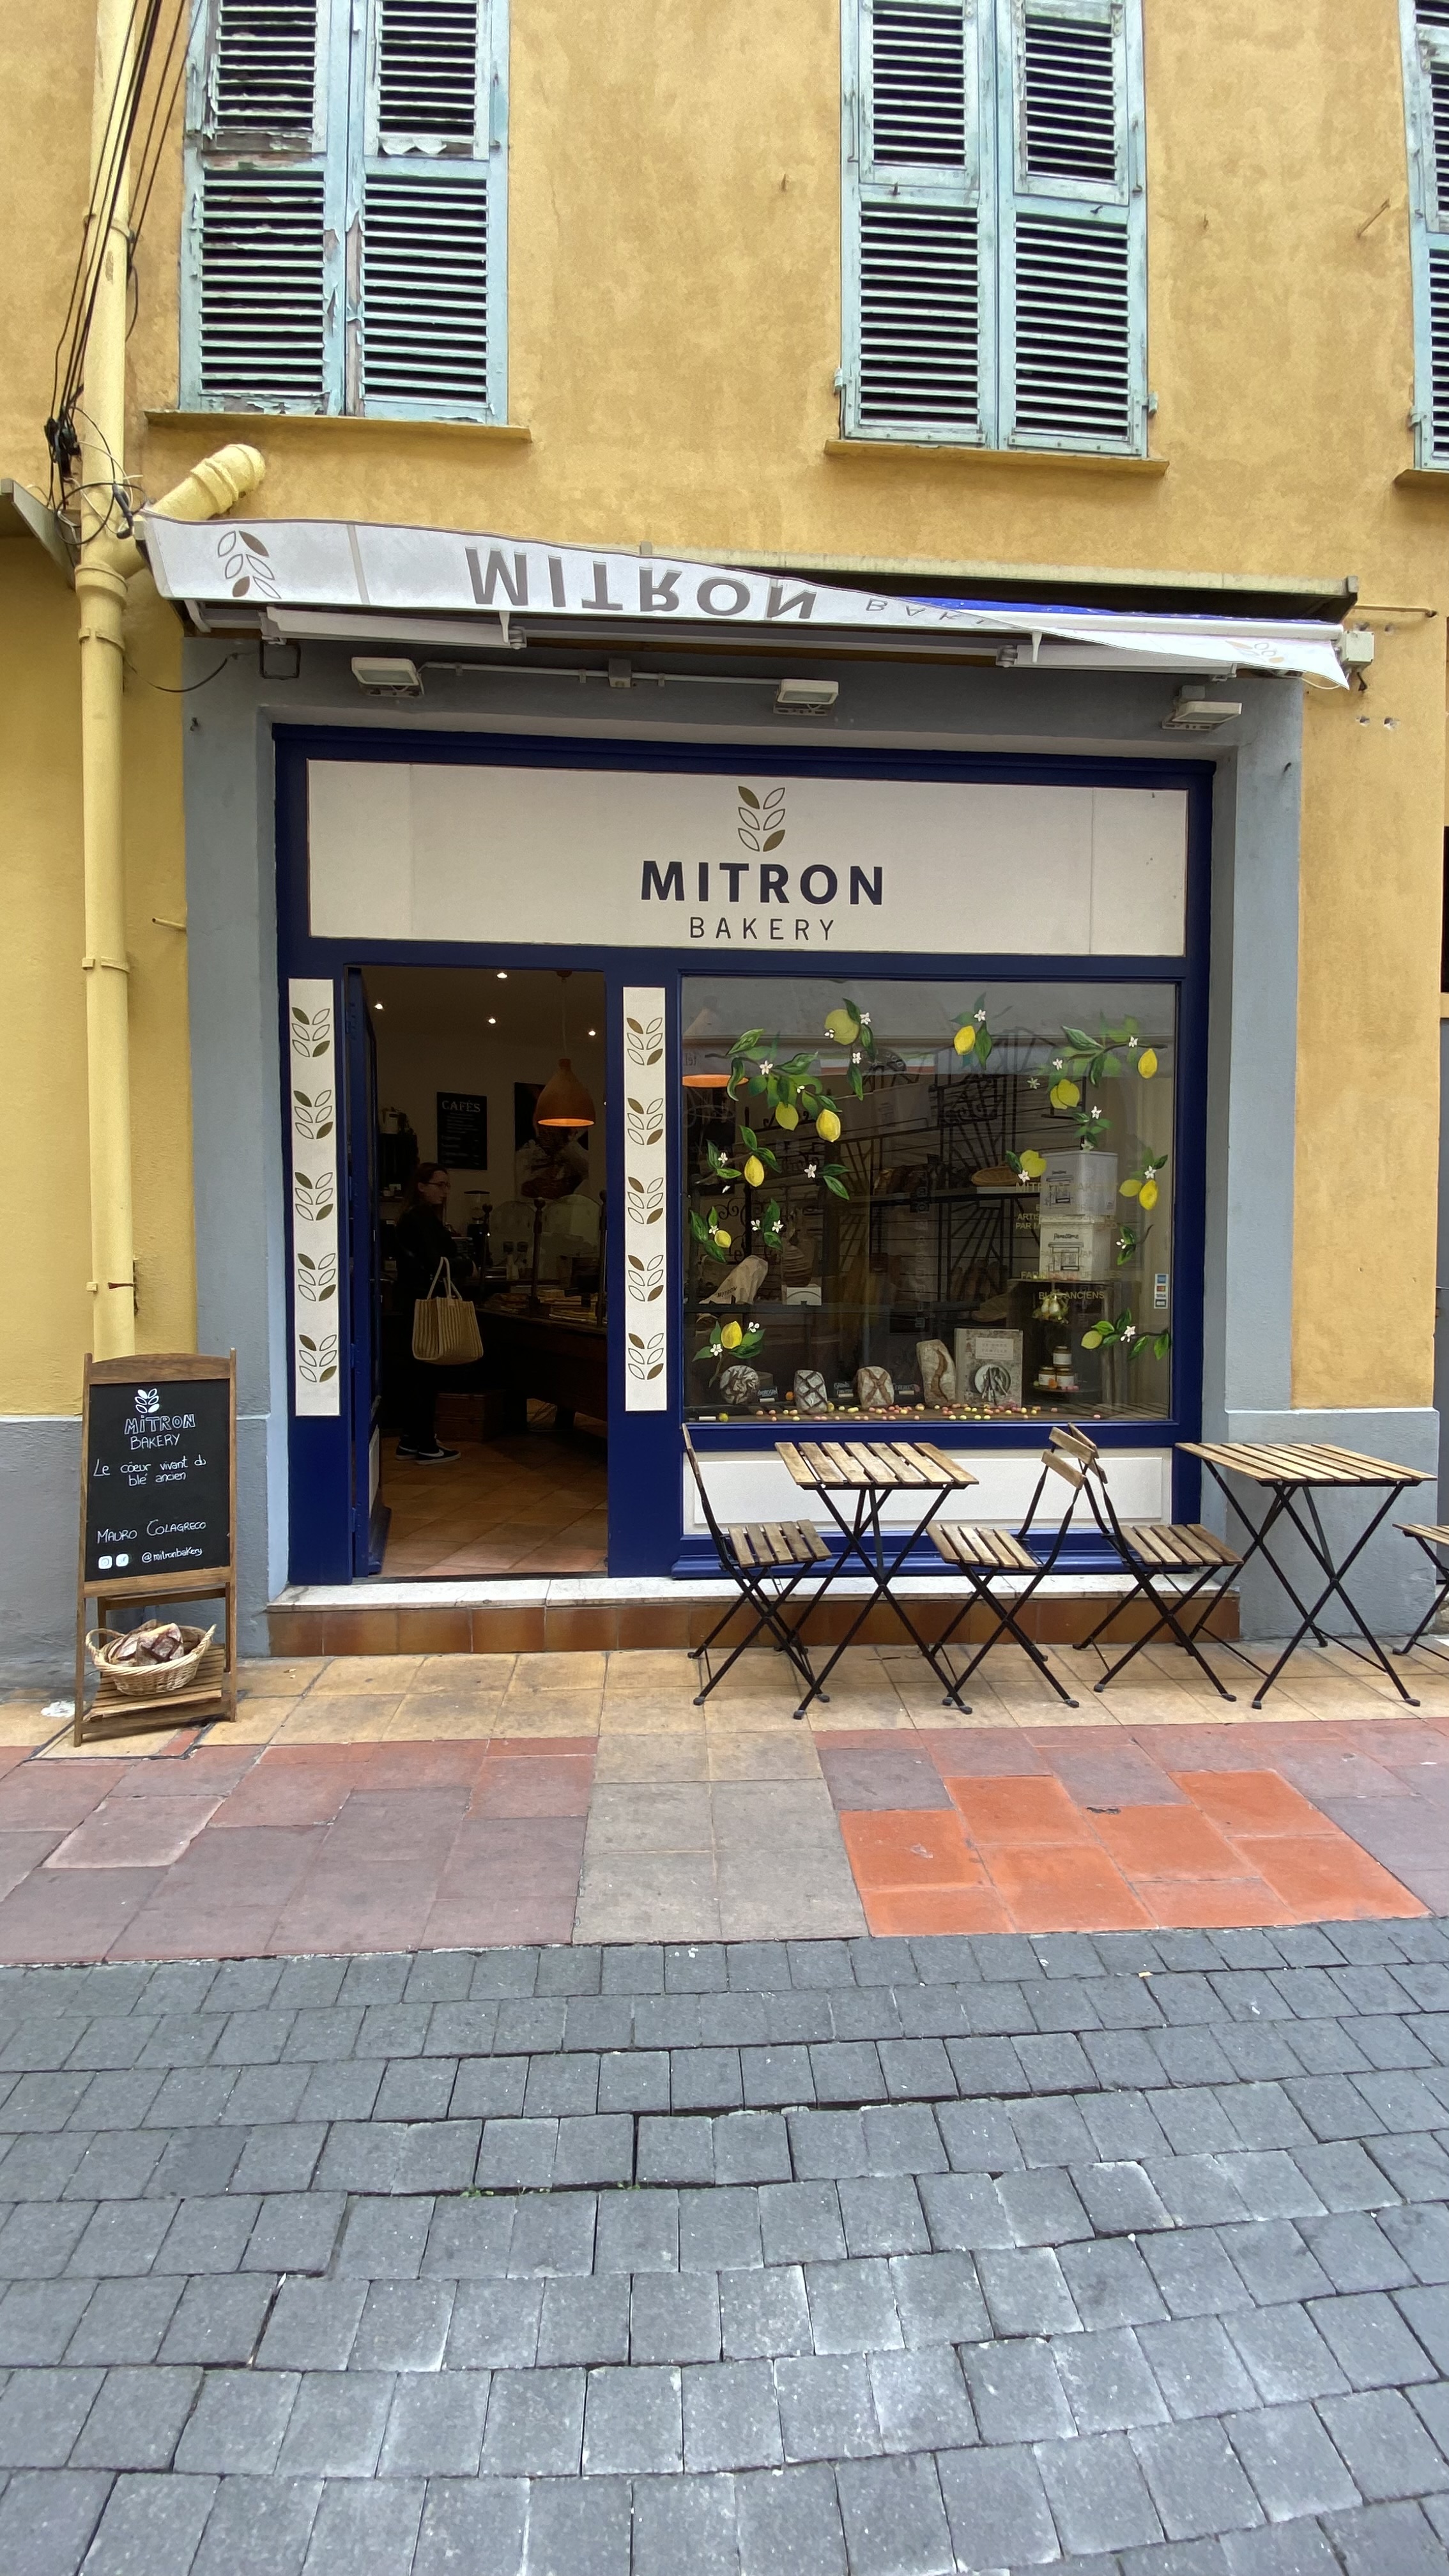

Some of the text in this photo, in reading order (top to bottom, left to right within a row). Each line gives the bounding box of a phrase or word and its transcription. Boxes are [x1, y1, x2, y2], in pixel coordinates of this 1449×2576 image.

[641, 860, 883, 905] MITRON
[689, 916, 834, 941] BAKERY
[1065, 1291, 1105, 1300] ANCIENS
[130, 1433, 181, 1450] BAKERY
[93, 1458, 111, 1476] Le
[159, 1455, 189, 1471] vivant
[194, 1454, 207, 1466] du
[128, 1471, 187, 1487] blé ancien
[96, 1519, 206, 1544] MAURO COLAGRECO
